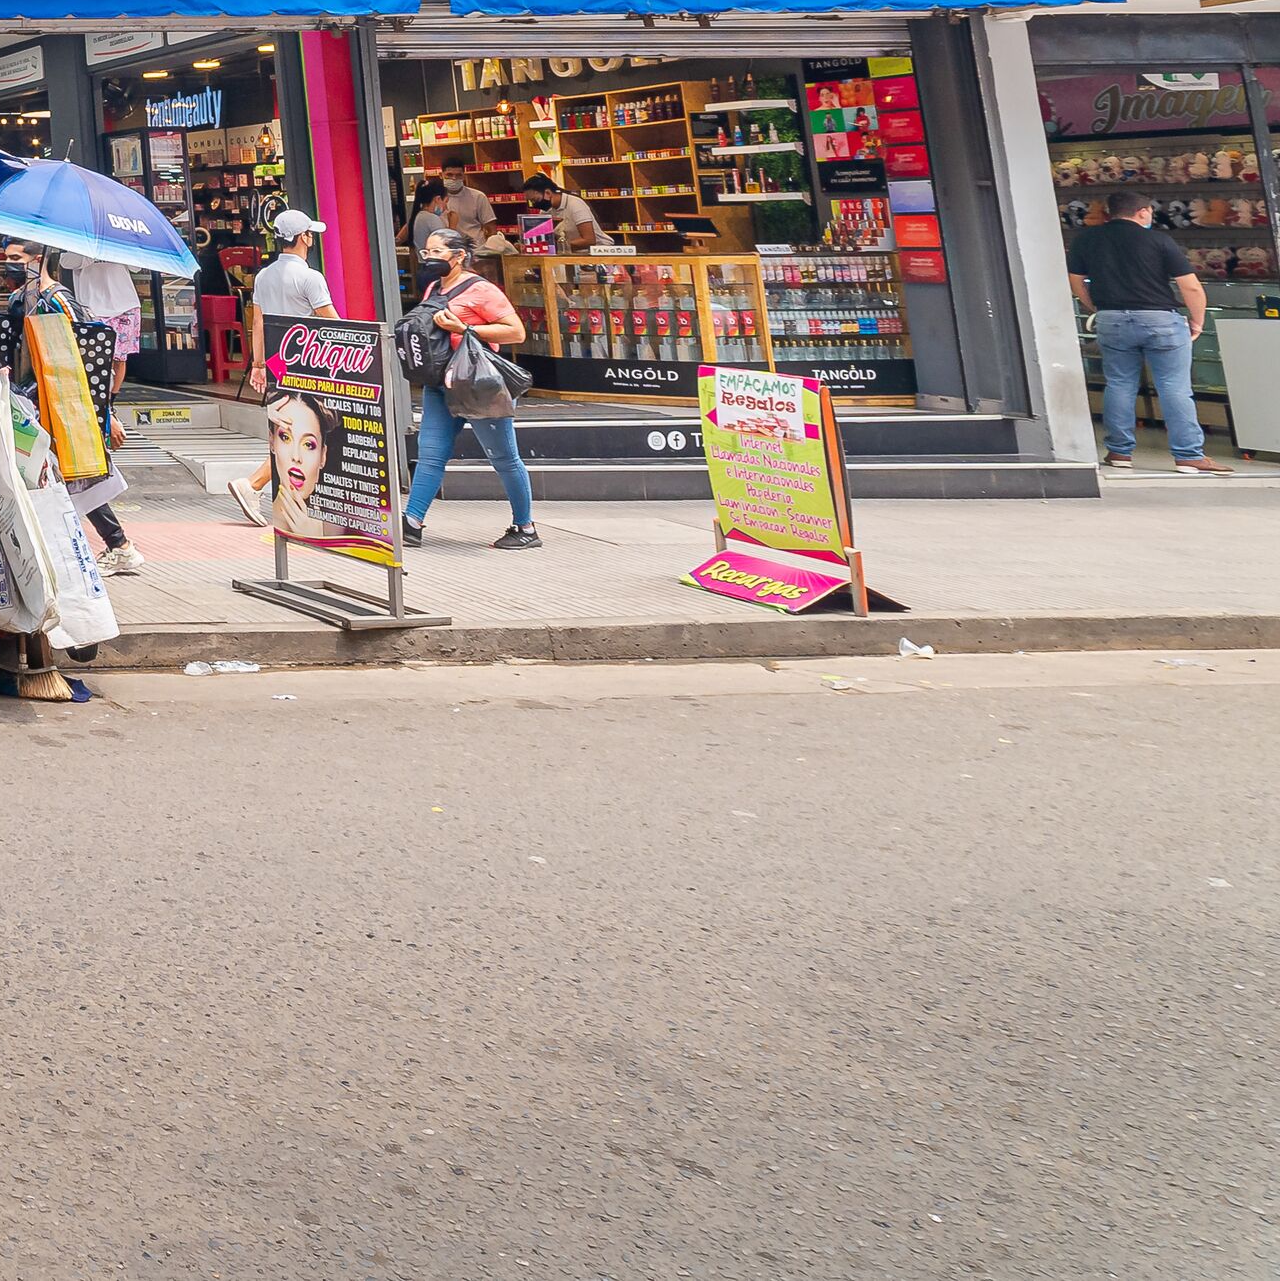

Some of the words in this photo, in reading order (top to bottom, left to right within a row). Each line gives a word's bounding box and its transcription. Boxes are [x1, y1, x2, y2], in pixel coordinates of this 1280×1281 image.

[454, 57, 686, 92] TANGO
[107, 213, 152, 236] BBVA
[279, 323, 375, 380] Chiqui
[410, 334, 424, 367] TOTTO
[317, 379, 335, 393] PARA
[335, 383, 345, 395] LA
[345, 384, 376, 399] BELLEZA
[719, 373, 797, 397] EMPACAMOS
[324, 398, 352, 412] LOCALES
[721, 391, 797, 414] Regalos
[342, 416, 362, 432] TODO
[362, 419, 384, 436] PARA
[740, 434, 784, 454] Internet
[341, 463, 379, 479] MAQUILLAJE
[710, 445, 761, 466] Llamadas
[762, 454, 822, 478] Nacionales
[315, 483, 346, 499] MANICURE
[351, 492, 380, 508] PEDICURE
[323, 473, 353, 489] ESMALTES
[358, 481, 380, 495] TINTES
[700, 559, 809, 601] Recargas
